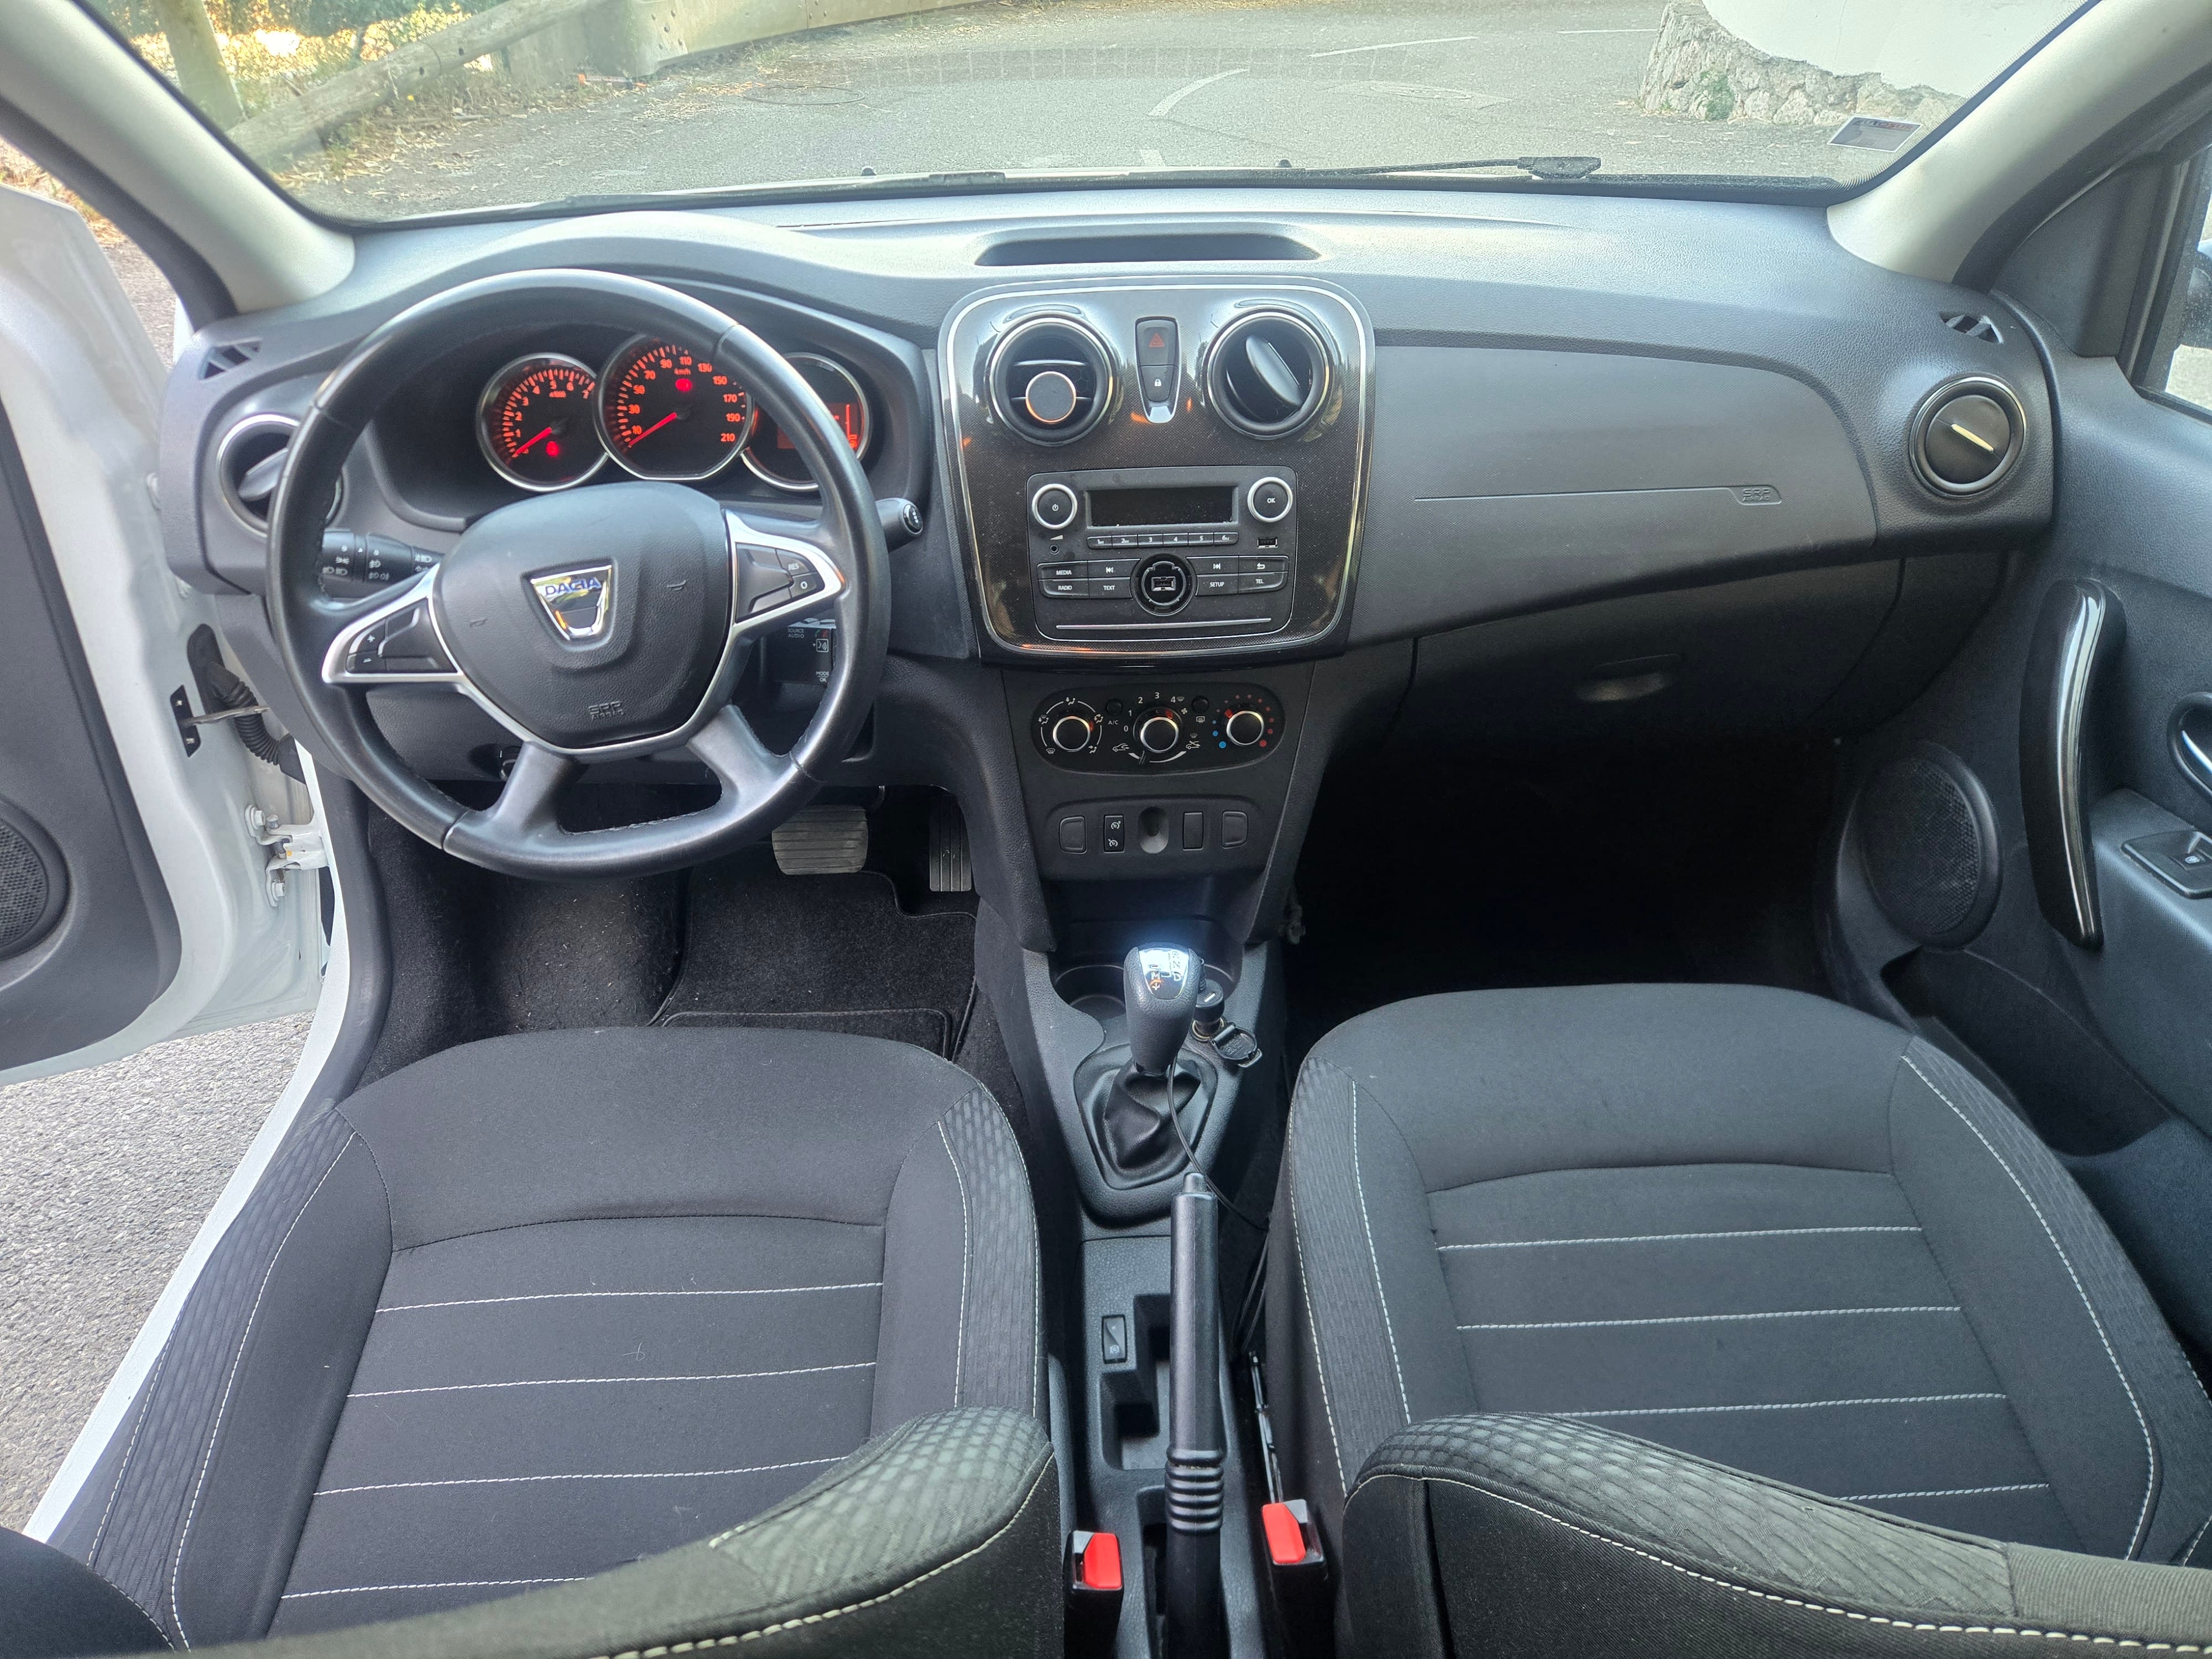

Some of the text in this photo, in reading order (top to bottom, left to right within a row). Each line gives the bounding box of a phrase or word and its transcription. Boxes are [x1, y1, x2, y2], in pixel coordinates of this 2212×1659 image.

[1854, 119, 1913, 129] AUTOSUR
[660, 359, 672, 369] 90
[679, 356, 692, 366] 110
[712, 375, 727, 385] 150
[723, 394, 737, 403] 170
[628, 404, 640, 414] 30
[515, 411, 523, 421] 2
[726, 413, 740, 422] 190
[632, 425, 642, 435] 10
[720, 433, 735, 442] 210
[545, 577, 602, 596] DACIA
[1151, 971, 1160, 980] M
